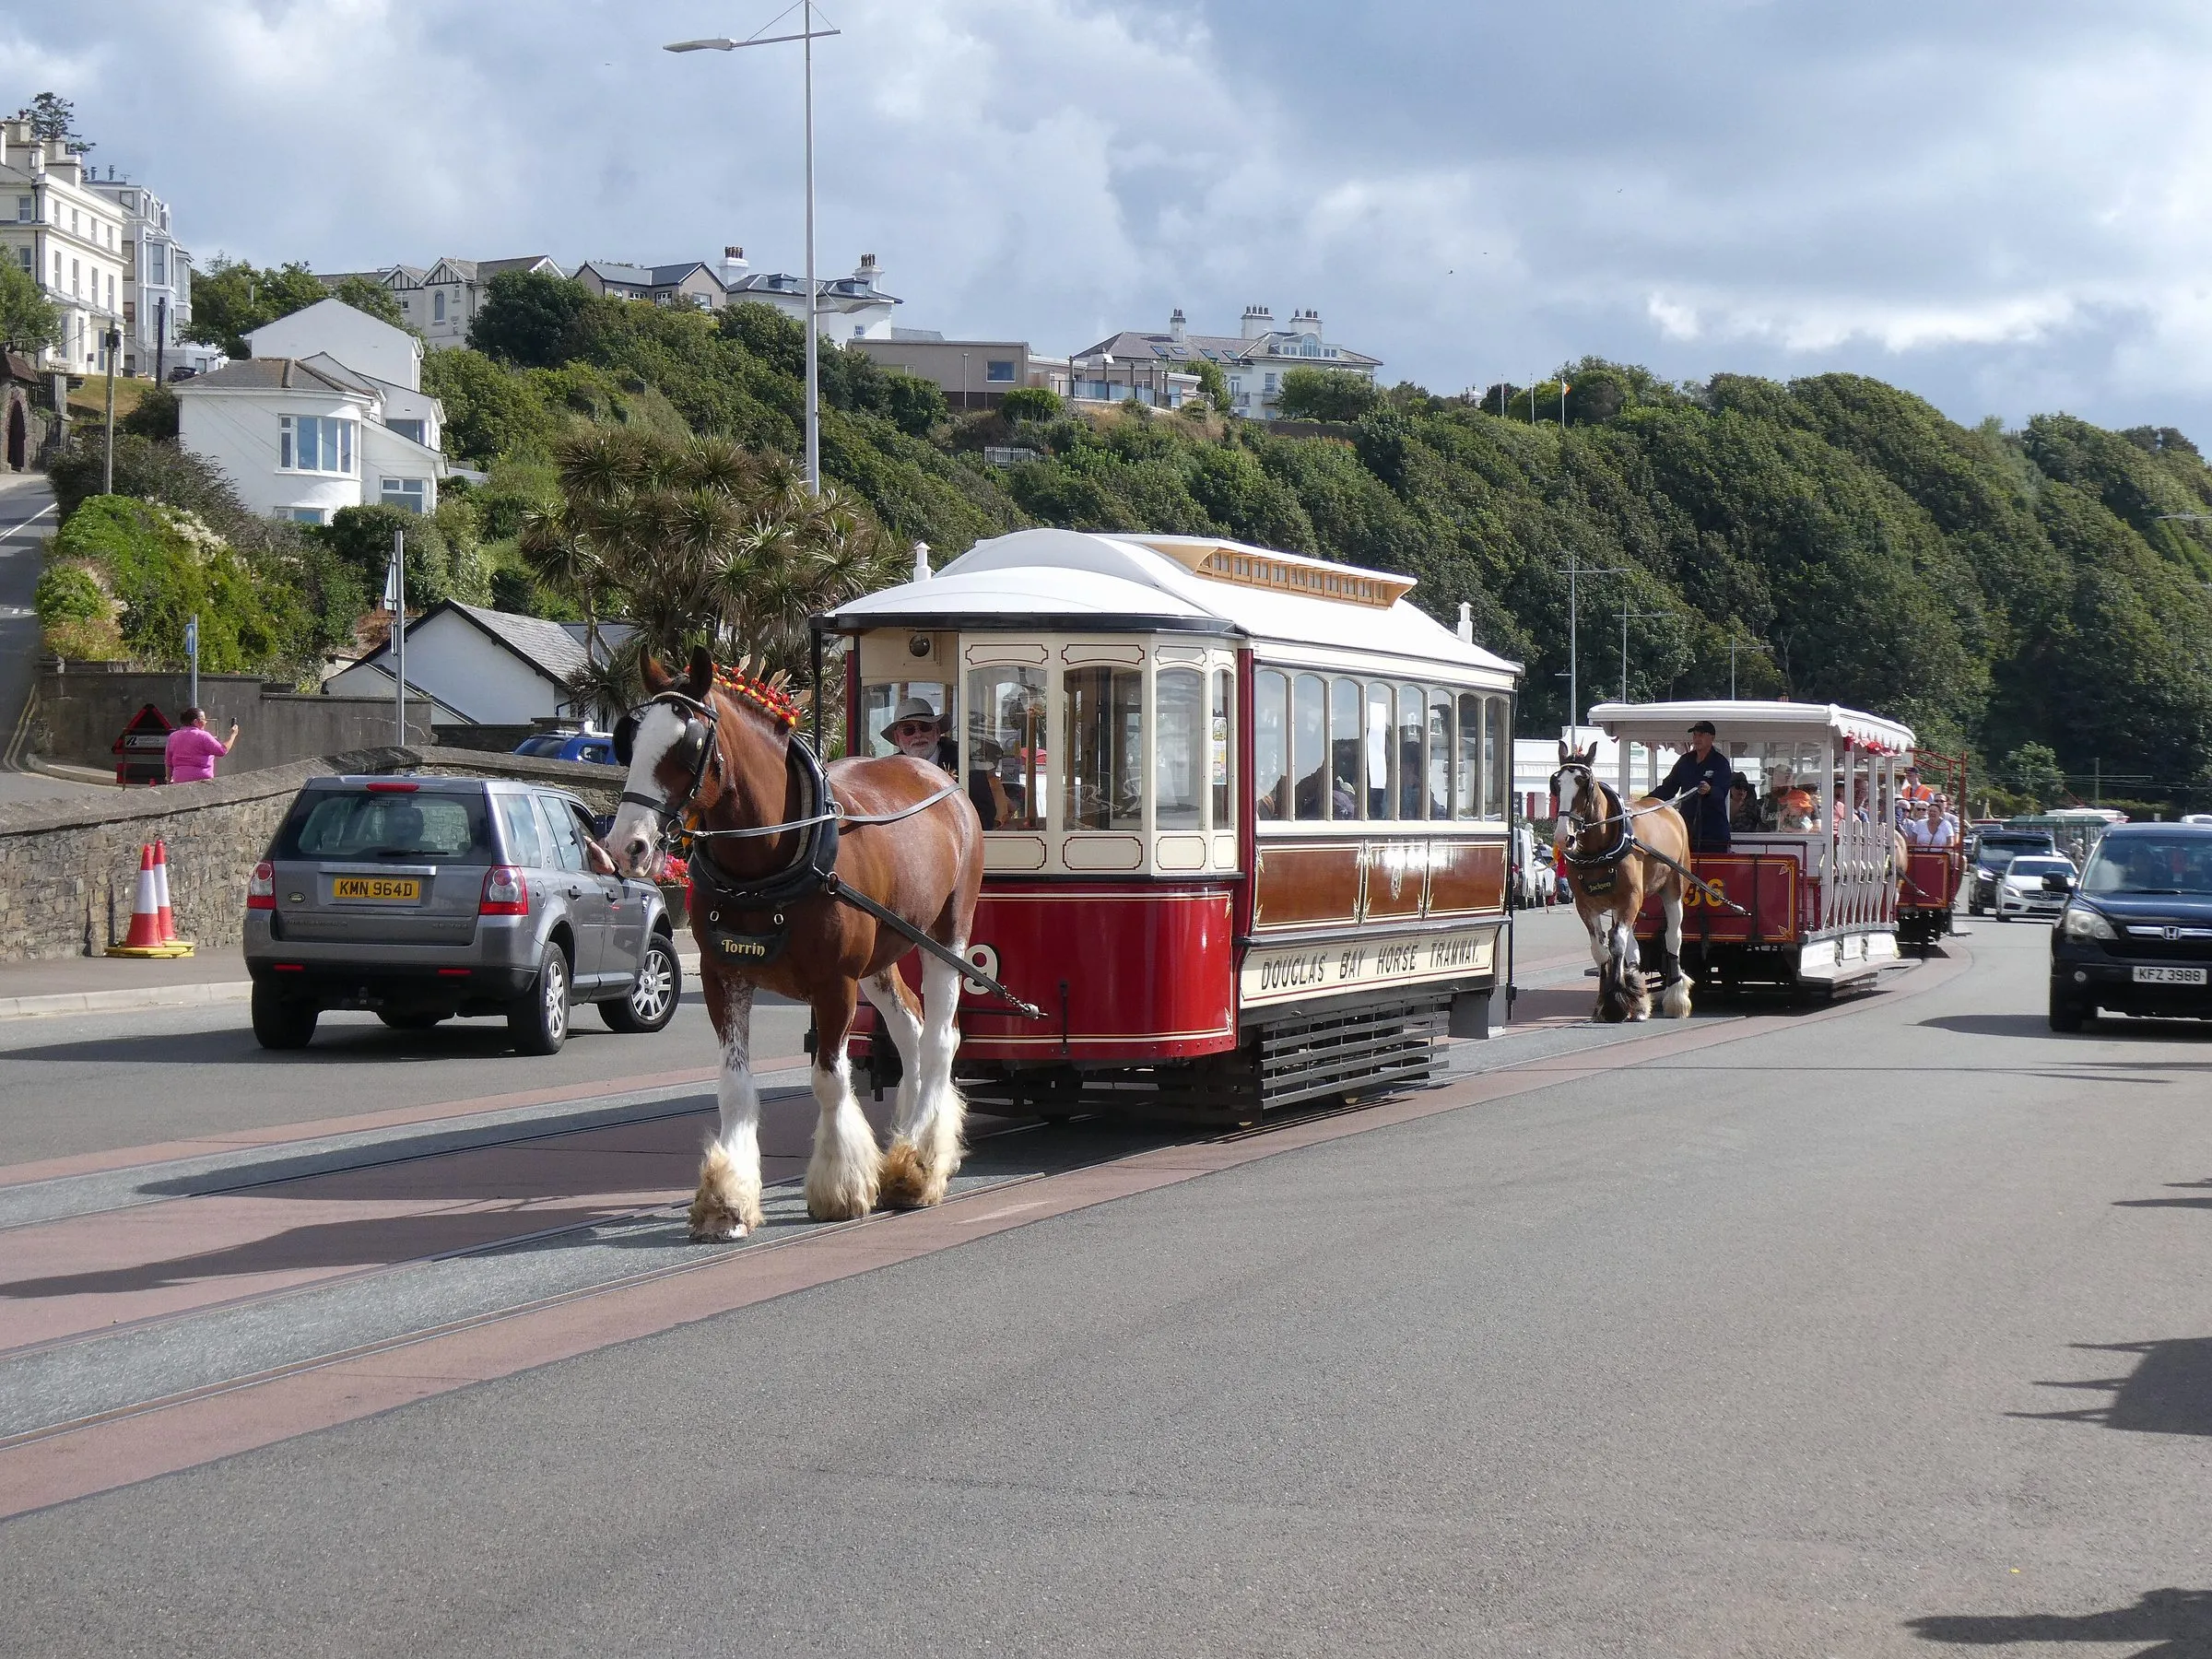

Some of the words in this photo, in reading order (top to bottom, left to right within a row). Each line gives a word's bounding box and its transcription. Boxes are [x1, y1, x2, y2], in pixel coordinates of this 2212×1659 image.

[339, 880, 369, 896] KMN
[372, 882, 412, 897] 964D
[1588, 882, 1611, 892] Jackson
[721, 939, 766, 957] Torrin
[1261, 951, 1327, 990] DOUGLAS
[1339, 947, 1368, 979] BAY
[1376, 943, 1419, 974] HORSE
[2139, 968, 2164, 980] KFZ
[2167, 970, 2201, 982] 3988
